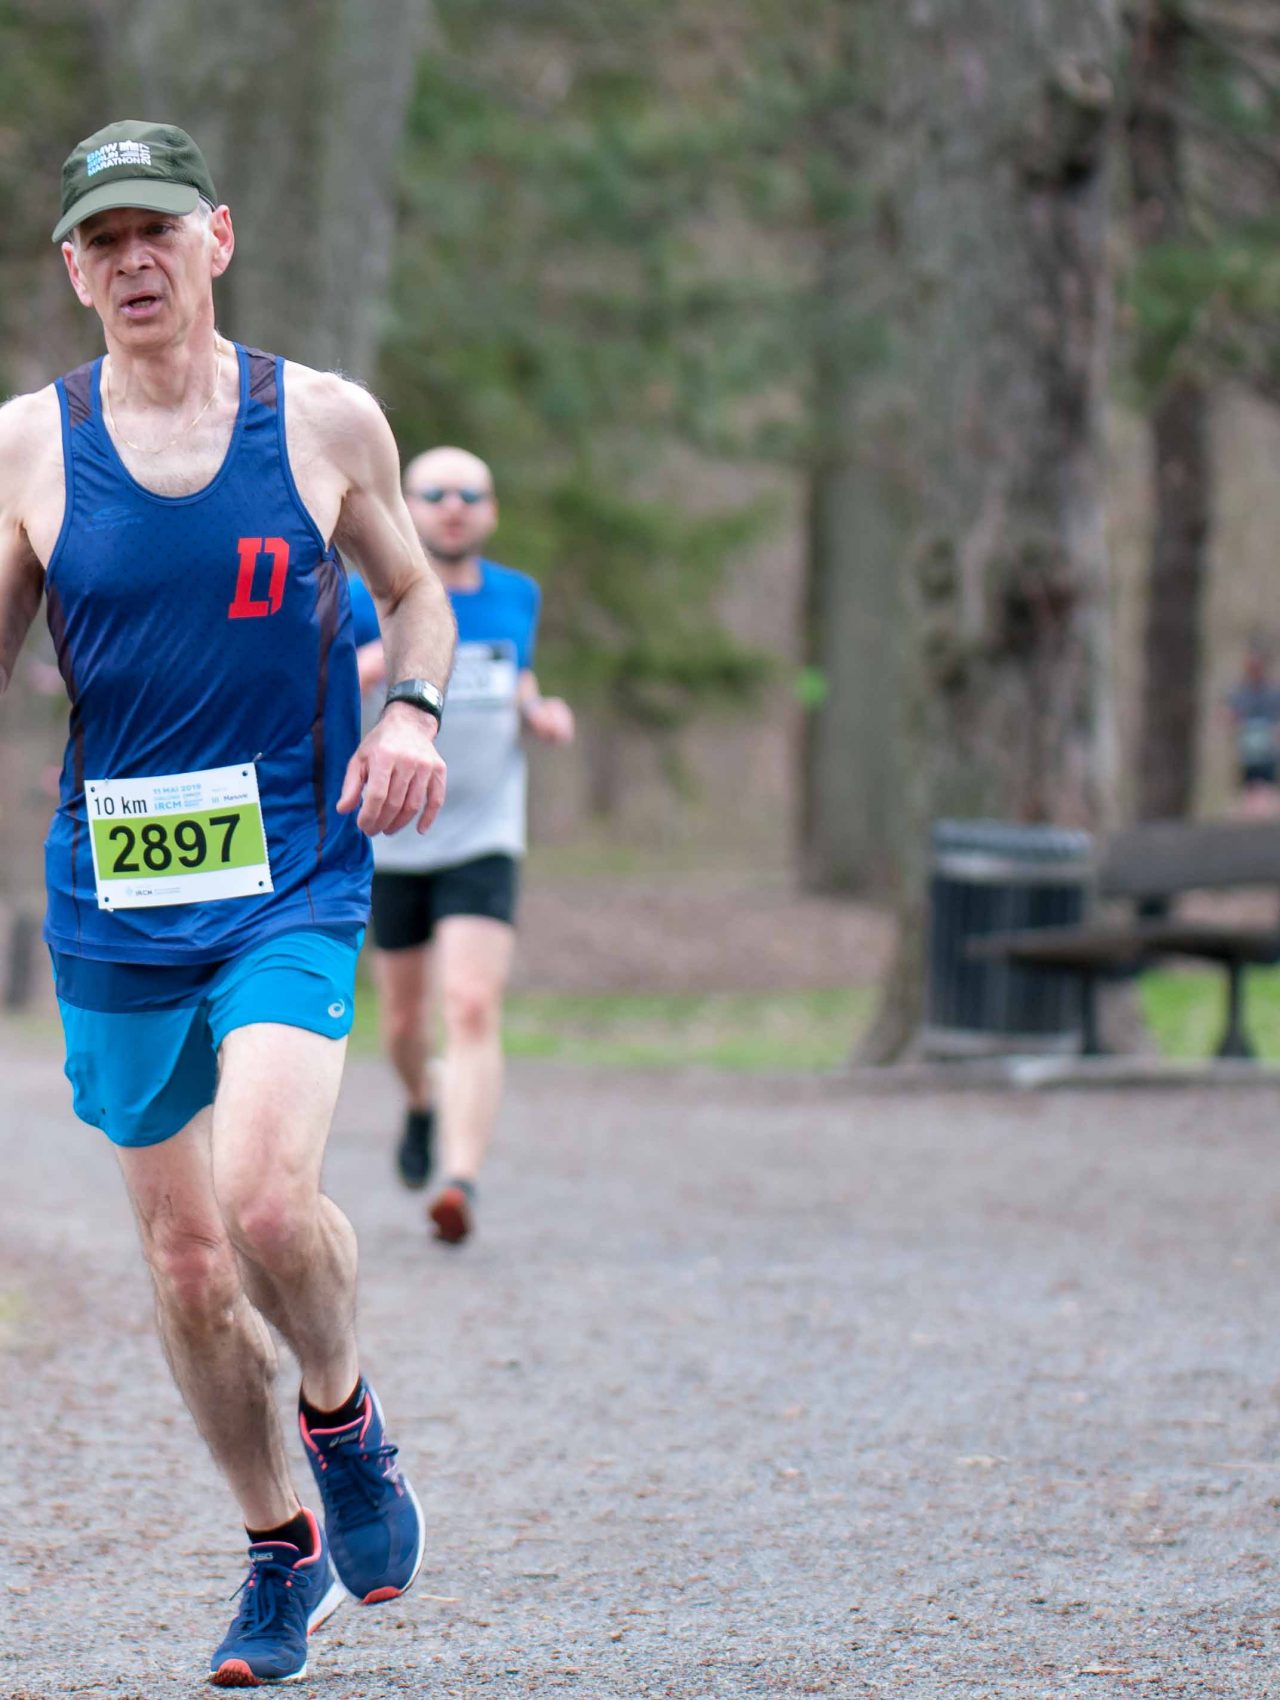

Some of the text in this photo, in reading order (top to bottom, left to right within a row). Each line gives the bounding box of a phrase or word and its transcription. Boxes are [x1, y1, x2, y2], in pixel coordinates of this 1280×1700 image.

[88, 157, 140, 176] MARATHON
[94, 796, 148, 815] 10 km
[154, 800, 181, 811] IRCM
[109, 814, 241, 873] 2897
